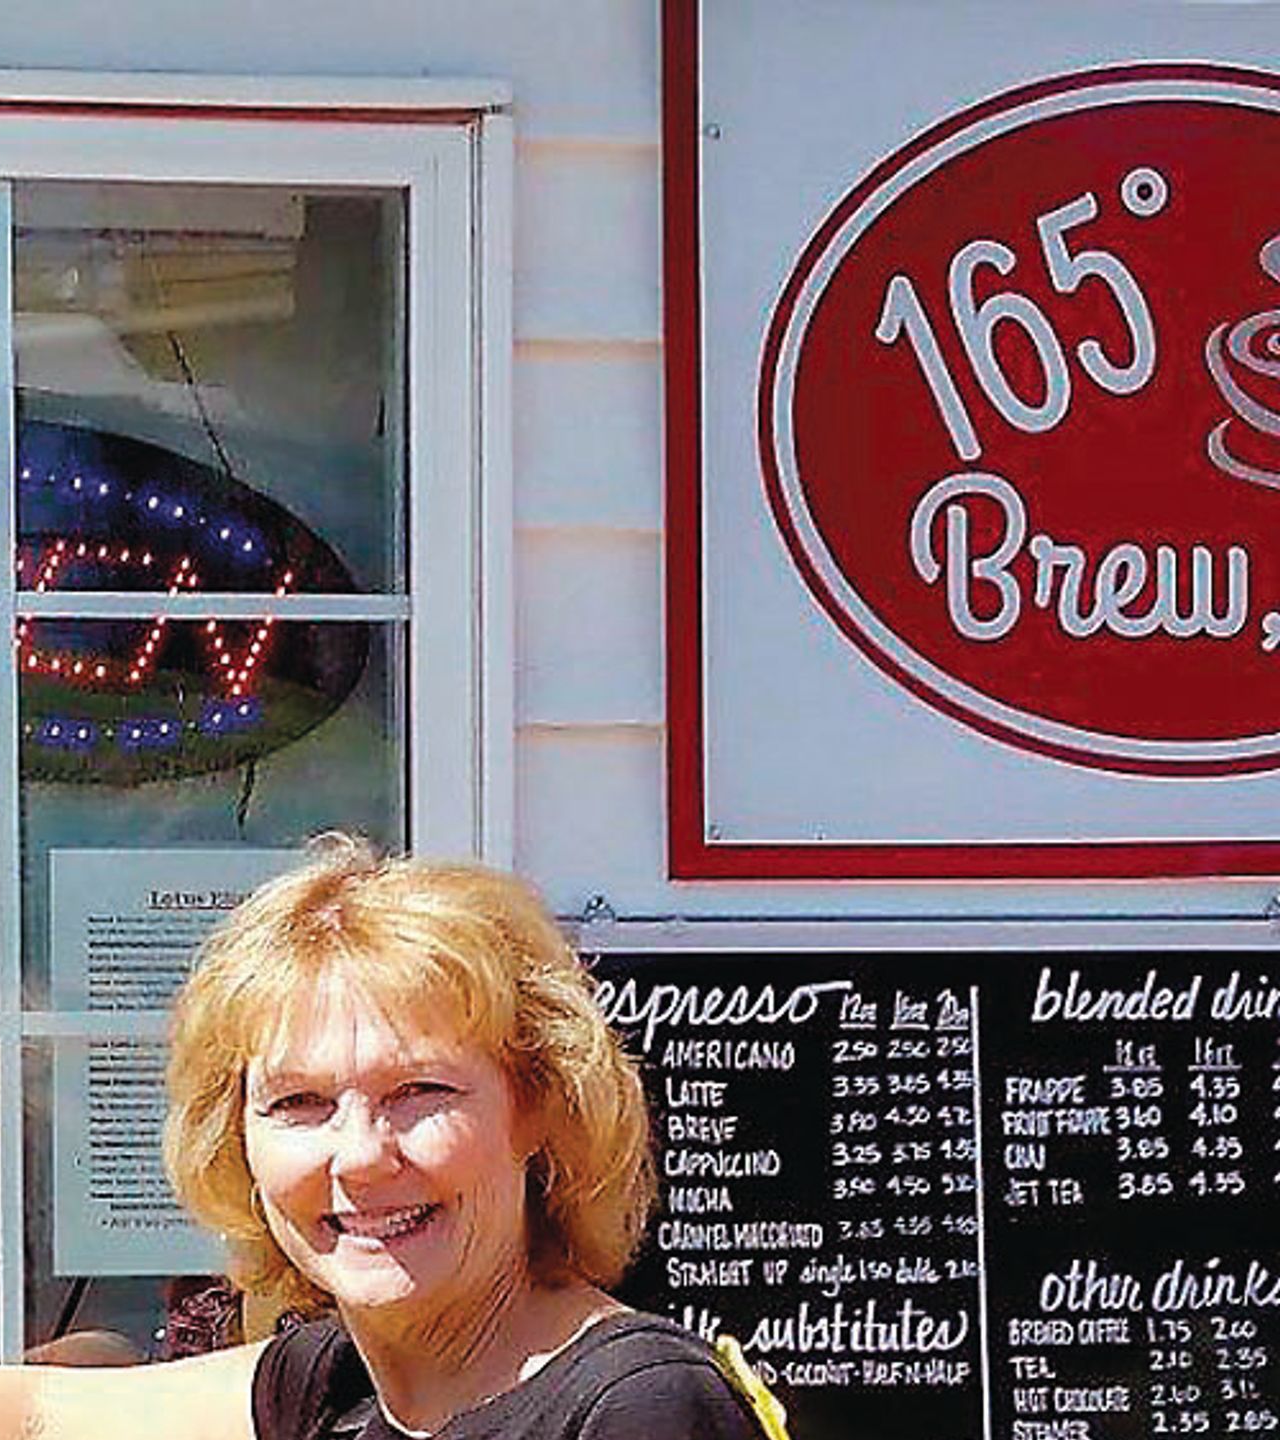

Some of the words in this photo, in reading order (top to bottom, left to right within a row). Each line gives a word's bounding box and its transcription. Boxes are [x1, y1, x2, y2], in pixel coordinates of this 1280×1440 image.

[1031, 966, 1202, 1021] blended
[594, 979, 853, 1052] espresso
[662, 1039, 795, 1069] AMERICANO
[666, 1077, 728, 1106] LATTE
[1005, 1075, 1086, 1104] FRAPPE
[1190, 1074, 1240, 1098] 4.35
[668, 1114, 738, 1144] BREVE
[1188, 1102, 1238, 1127] 4.10
[665, 1149, 781, 1177] CAPPUCCINO
[669, 1186, 734, 1213] MOCHA
[763, 1259, 788, 1285] UP
[800, 1254, 857, 1297] single
[1040, 1259, 1144, 1312] other
[742, 1299, 969, 1353] substitutes
[1008, 1317, 1074, 1346] BREWED
[1146, 1316, 1192, 1343] 1.75
[1008, 1356, 1057, 1380] TEA
[1013, 1387, 1050, 1413] HOT
[1054, 1385, 1130, 1413] CHOCOLATE
